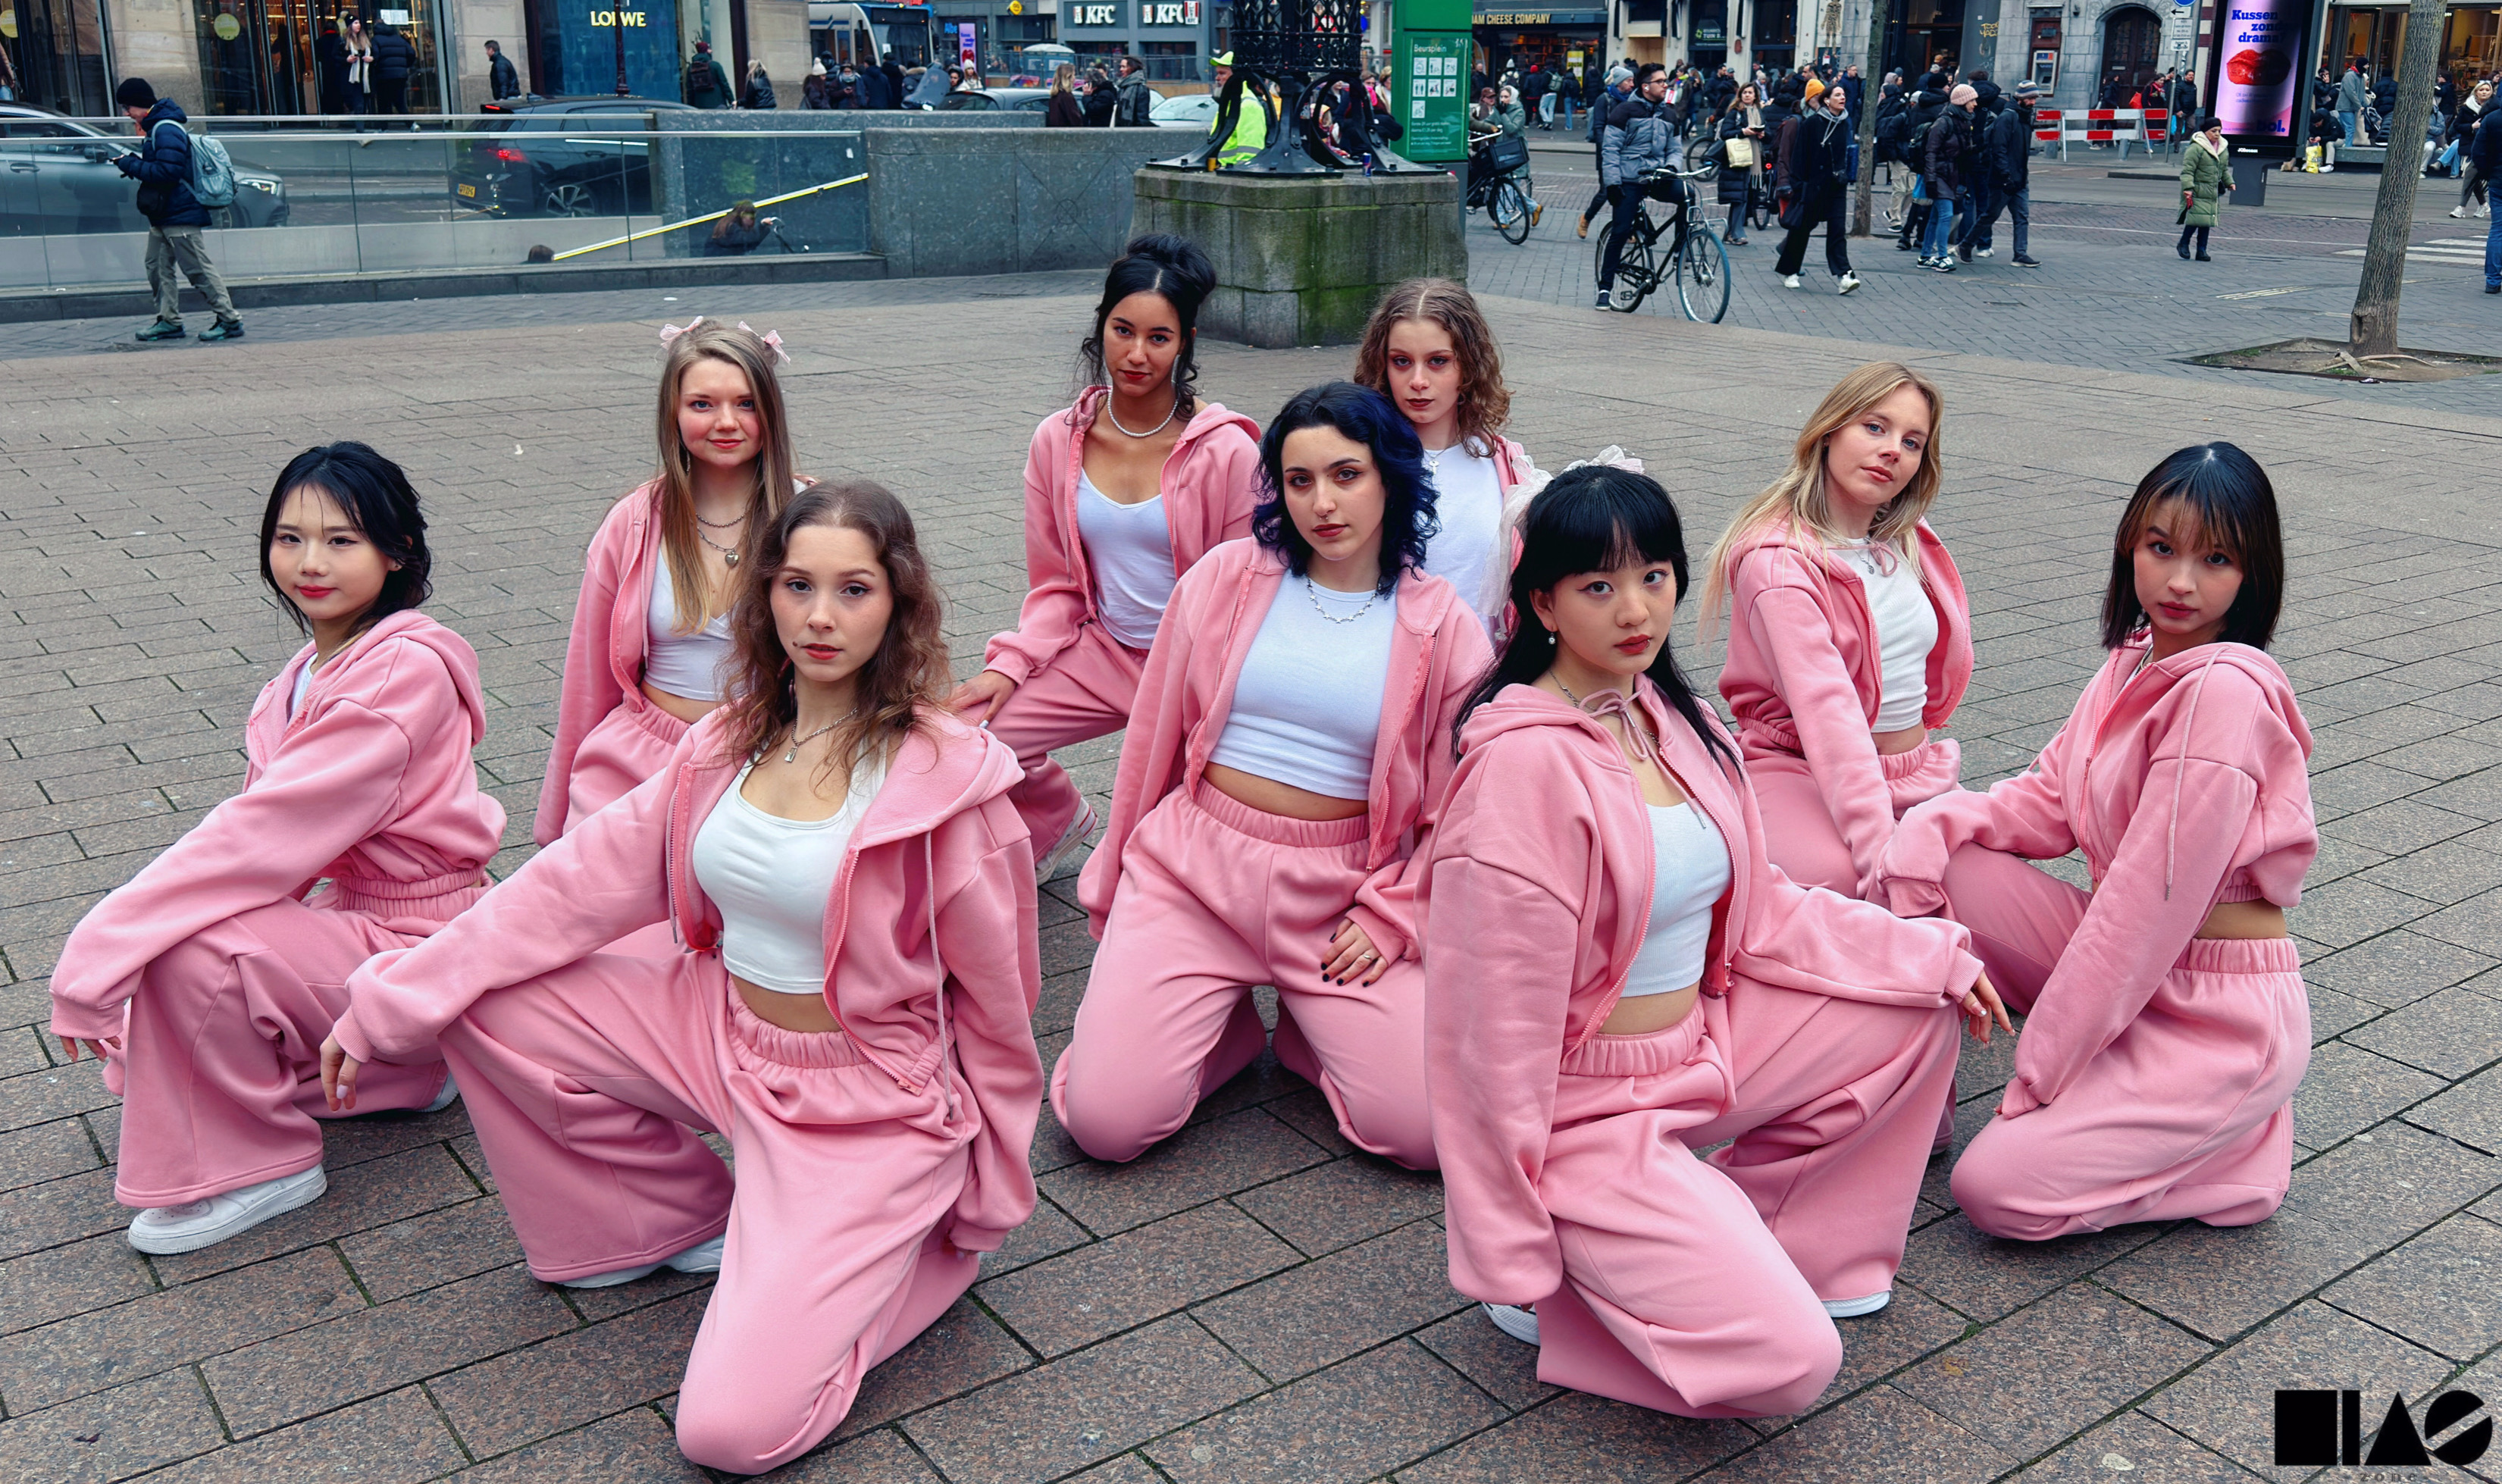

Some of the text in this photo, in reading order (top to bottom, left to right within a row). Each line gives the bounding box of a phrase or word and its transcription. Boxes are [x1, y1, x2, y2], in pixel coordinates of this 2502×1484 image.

[1085, 5, 1116, 23] KFC
[1487, 14, 1514, 24] CHEESE
[1515, 13, 1551, 24] COMPANY
[2231, 10, 2278, 20] Kussen
[1414, 44, 1447, 54] Beursplein
